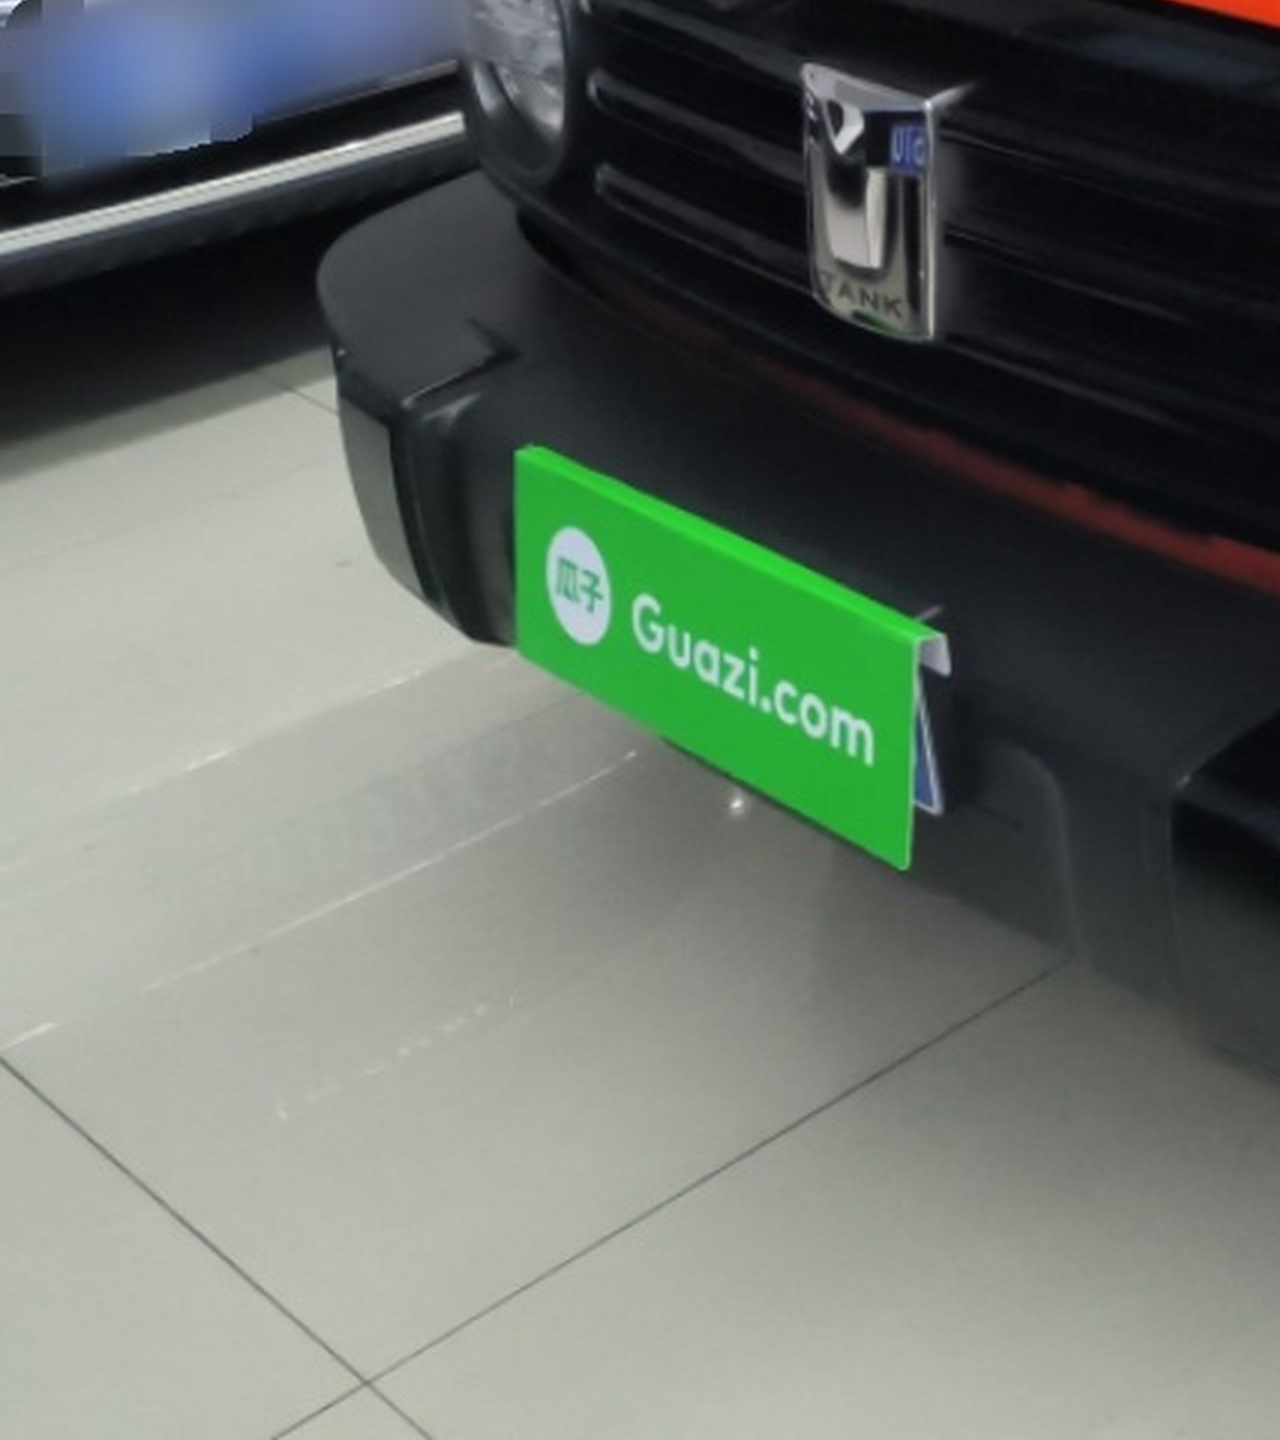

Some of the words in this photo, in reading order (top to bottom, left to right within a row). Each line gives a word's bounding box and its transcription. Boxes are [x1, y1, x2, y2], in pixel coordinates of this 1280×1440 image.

[819, 269, 902, 319] TANK
[556, 556, 604, 614] 瓜子
[631, 593, 875, 767] Guazi.com
